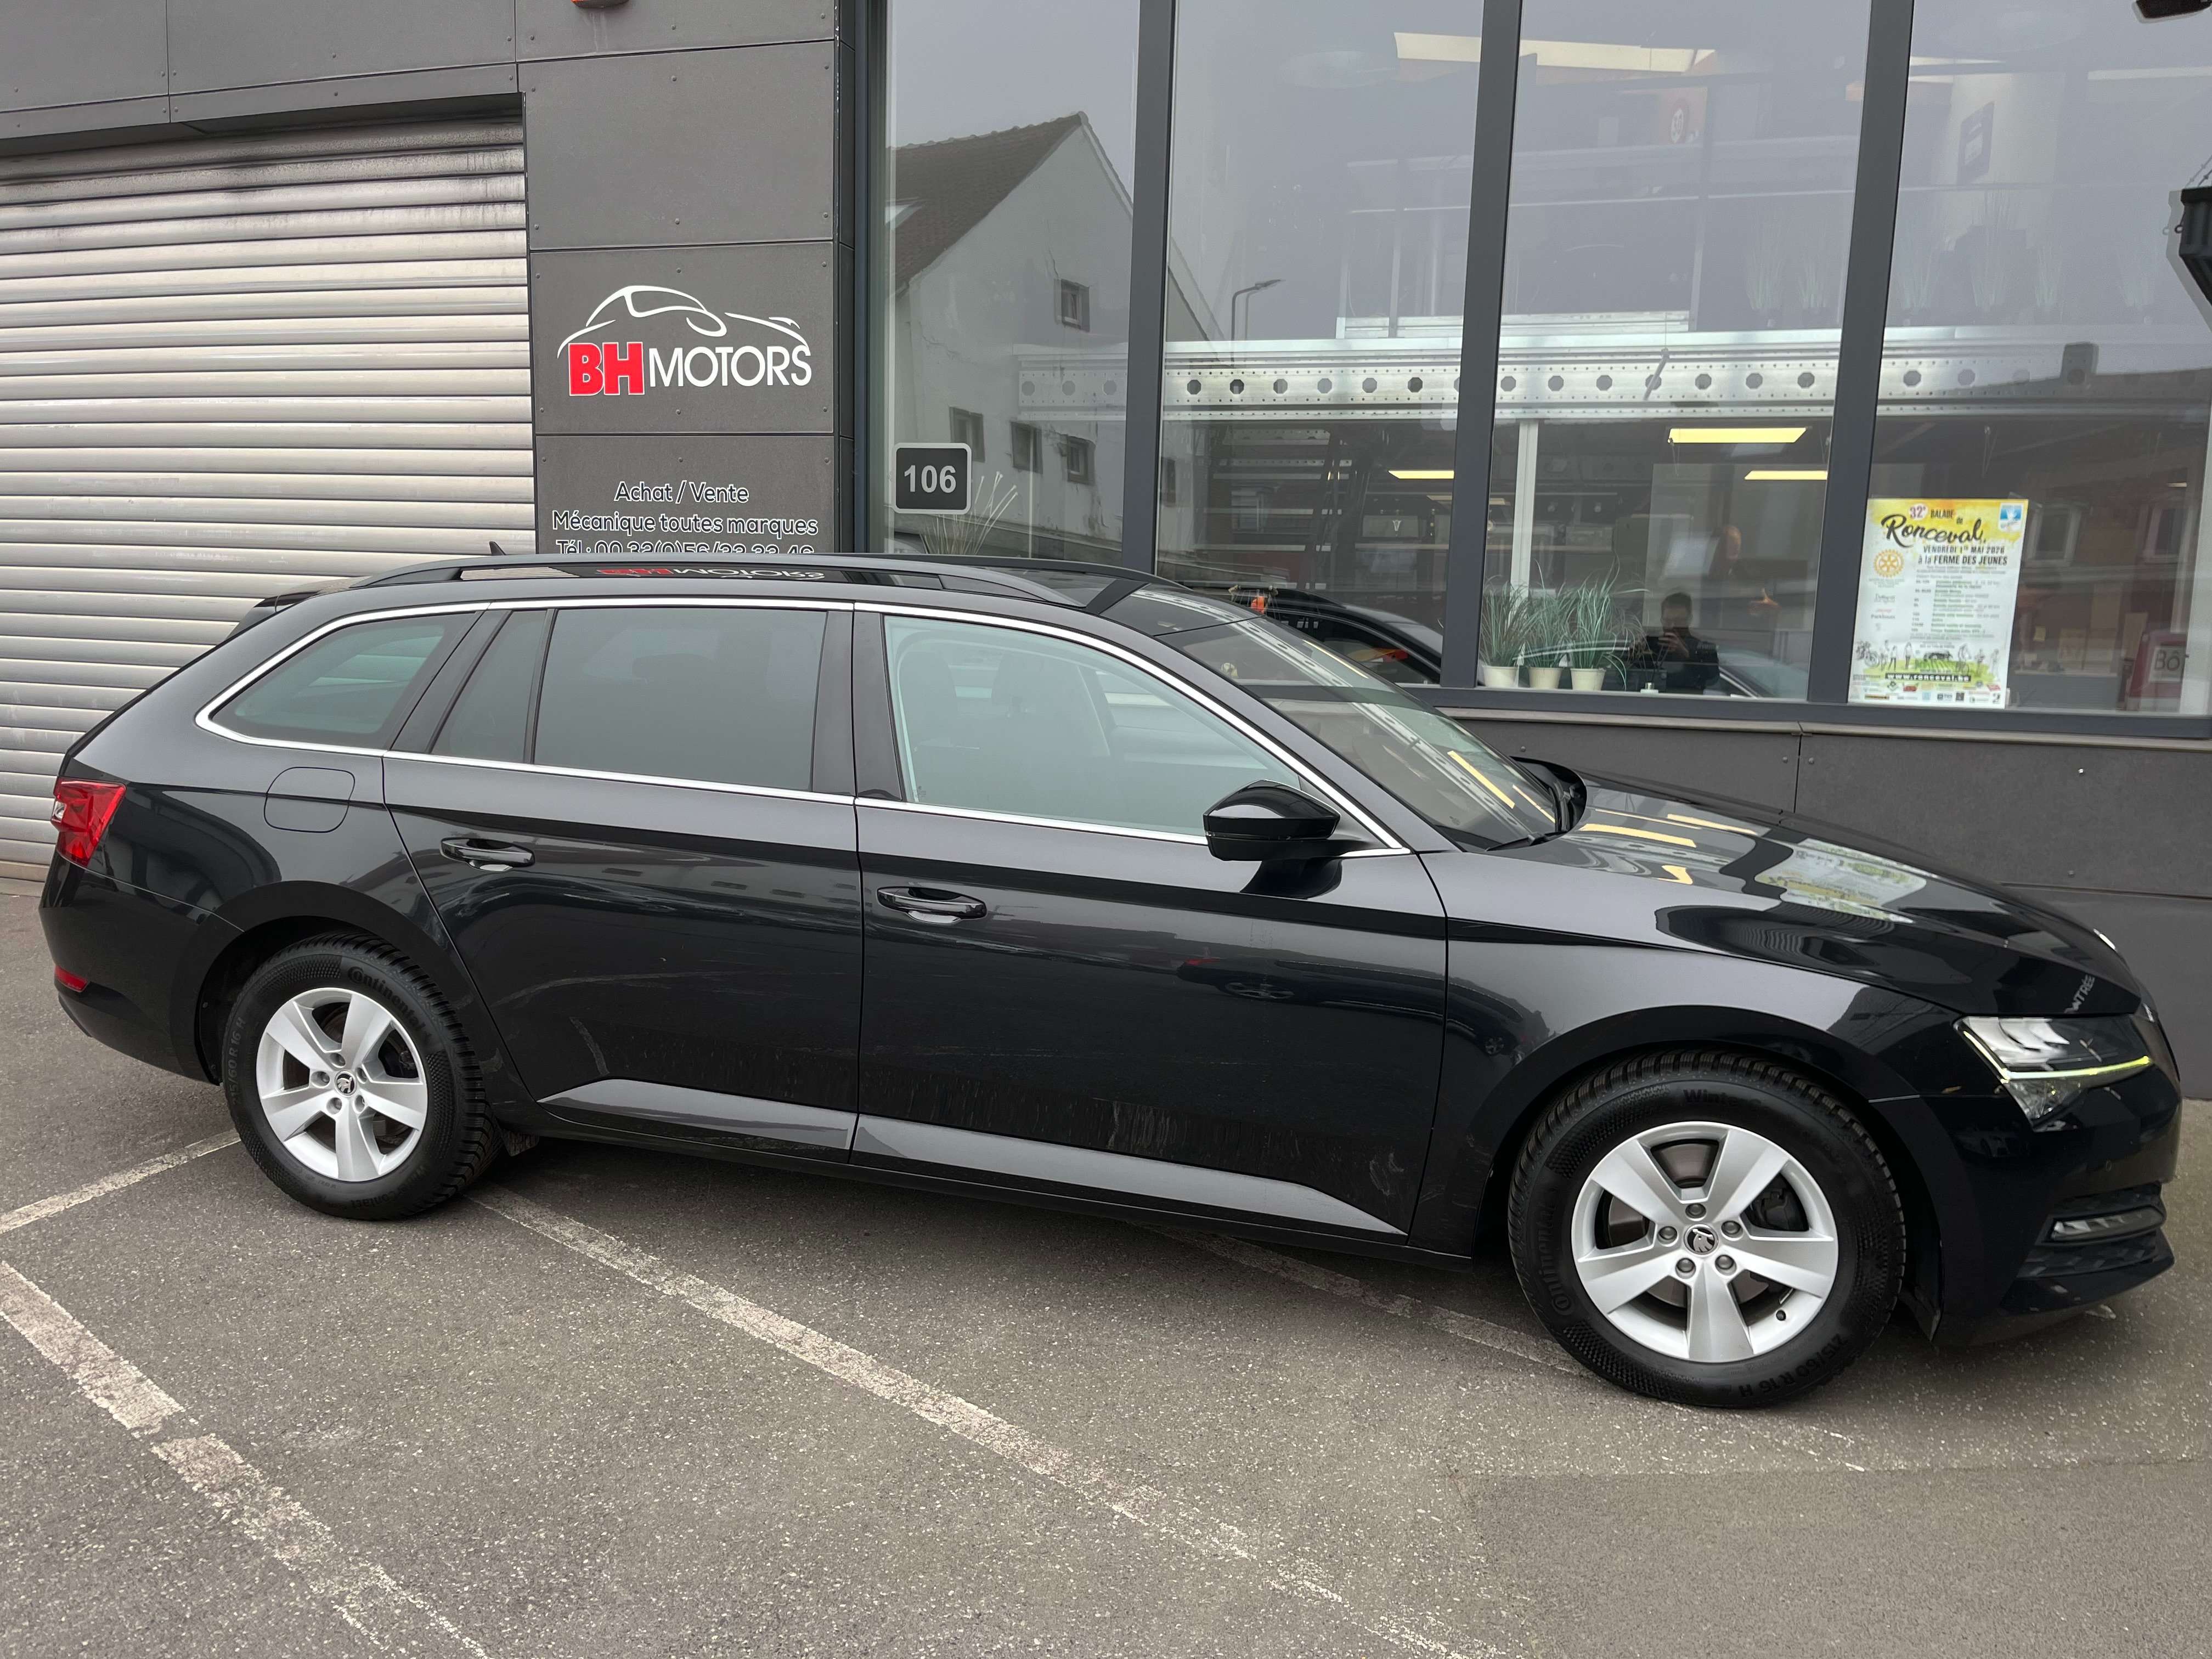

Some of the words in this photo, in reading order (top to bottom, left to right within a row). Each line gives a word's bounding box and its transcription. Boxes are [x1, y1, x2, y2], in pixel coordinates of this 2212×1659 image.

[568, 342, 645, 396] BH
[649, 345, 812, 387] MOTORS
[904, 465, 956, 493] 106
[613, 481, 674, 501] Achat
[690, 482, 749, 504] Vente
[552, 510, 656, 537] Mécanique
[659, 514, 723, 533] toutes
[727, 517, 819, 540] marques
[1931, 509, 1954, 518] BALADE
[1925, 555, 1932, 564] la
[1934, 555, 1960, 565] FERME
[1962, 556, 1976, 565] DES
[1979, 556, 2007, 566] JEUNES
[1971, 546, 1984, 554] MAI
